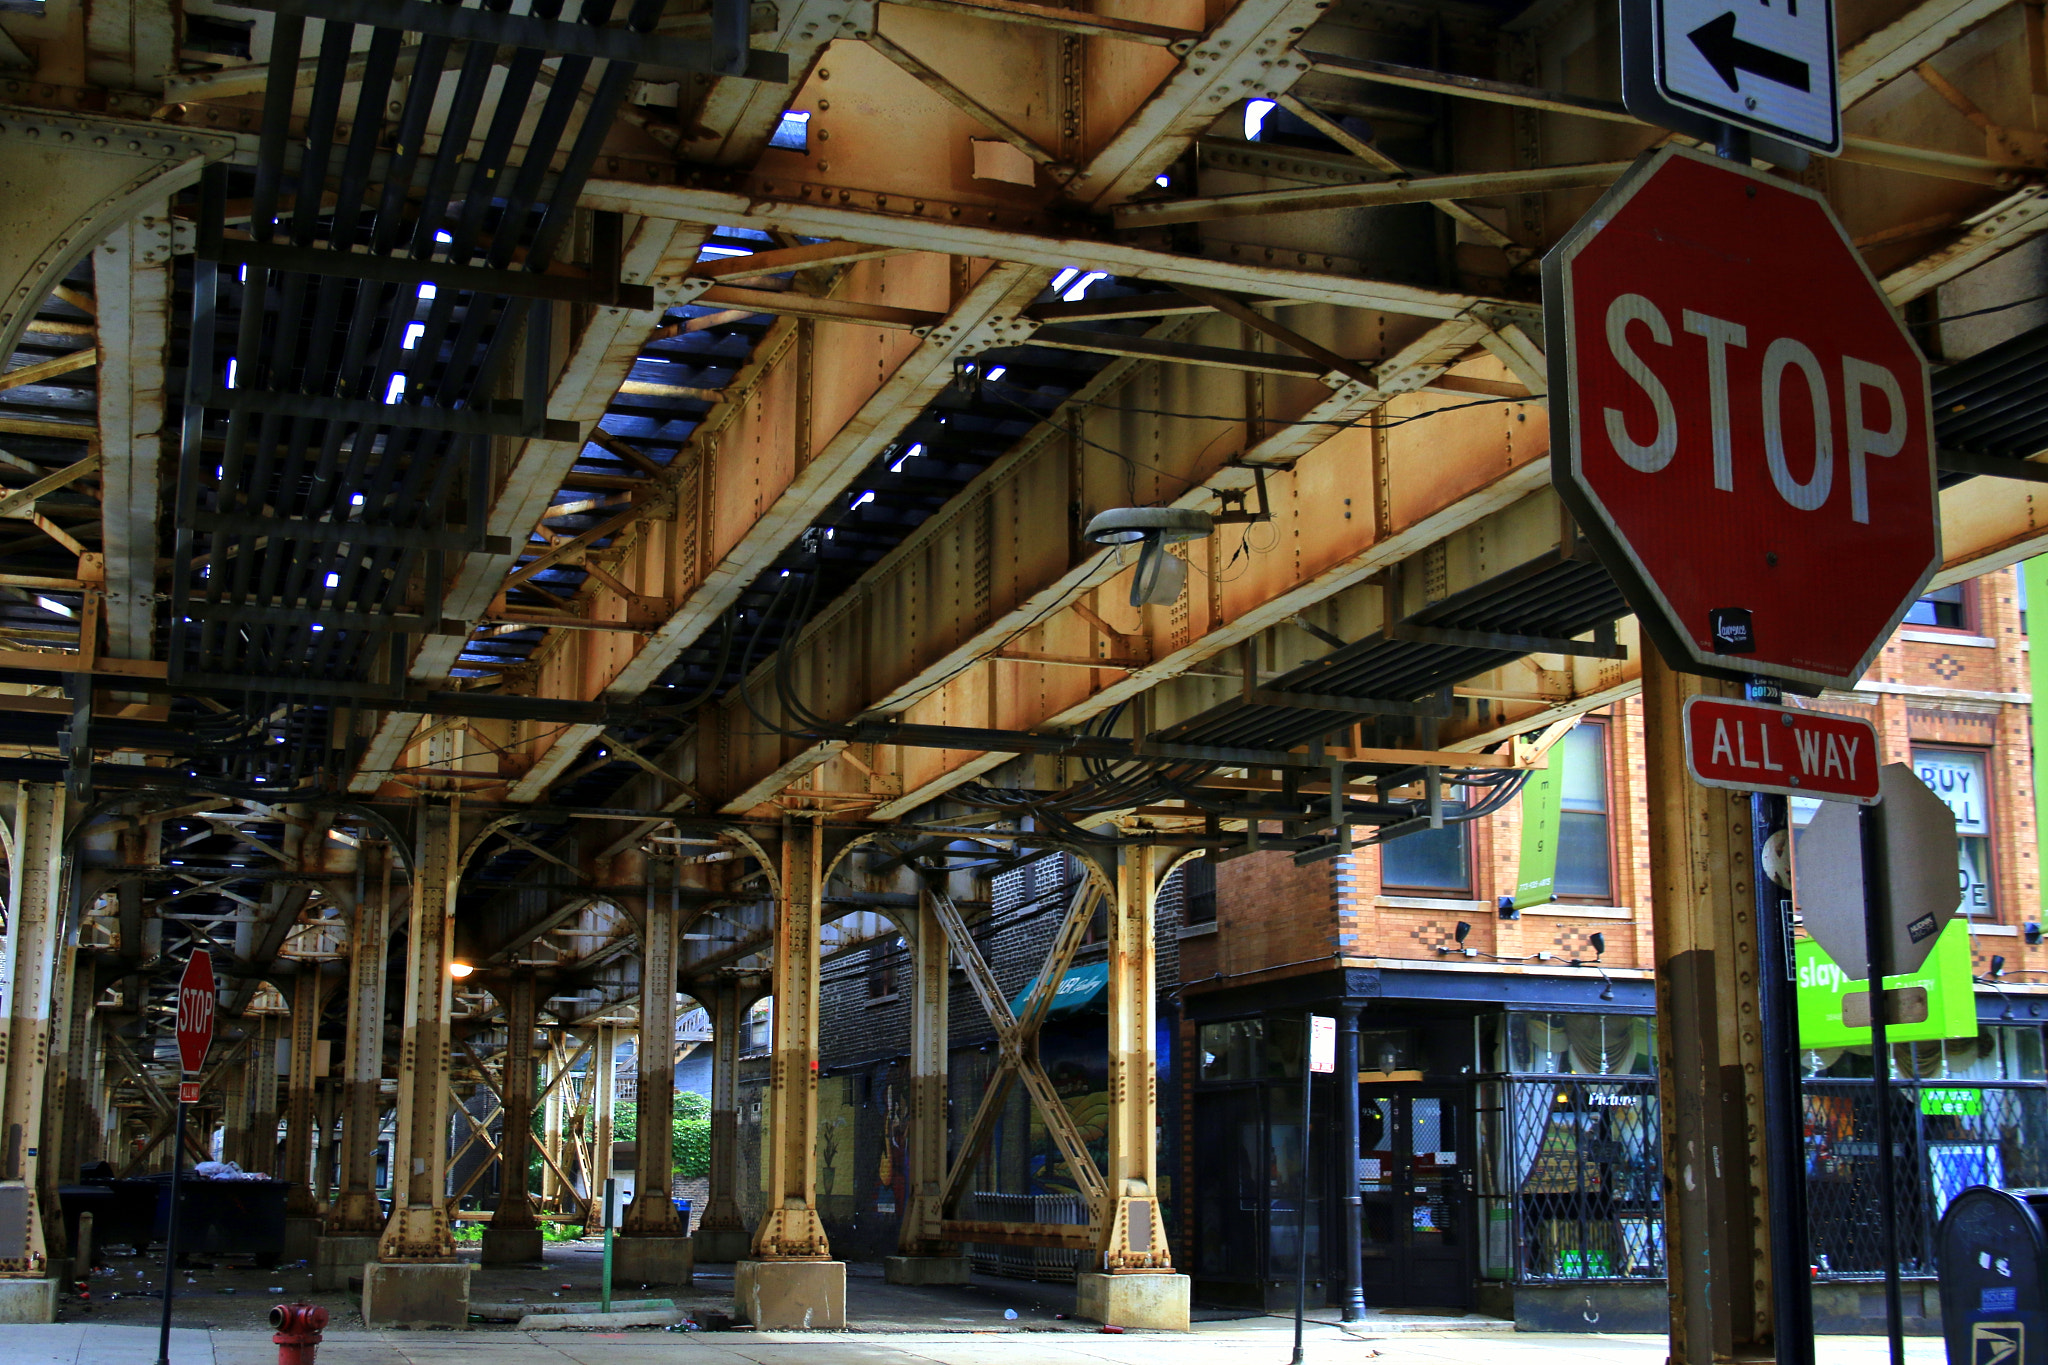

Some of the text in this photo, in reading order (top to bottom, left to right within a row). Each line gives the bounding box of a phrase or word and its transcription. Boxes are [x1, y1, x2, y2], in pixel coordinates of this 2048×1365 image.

[1603, 292, 1908, 526] STOP
[1711, 718, 1859, 781] ALL WAY
[1921, 767, 1970, 793] BUY
[180, 987, 213, 1034] STOP
[182, 1086, 191, 1099] ALL
[1588, 1092, 1637, 1106] Picture
